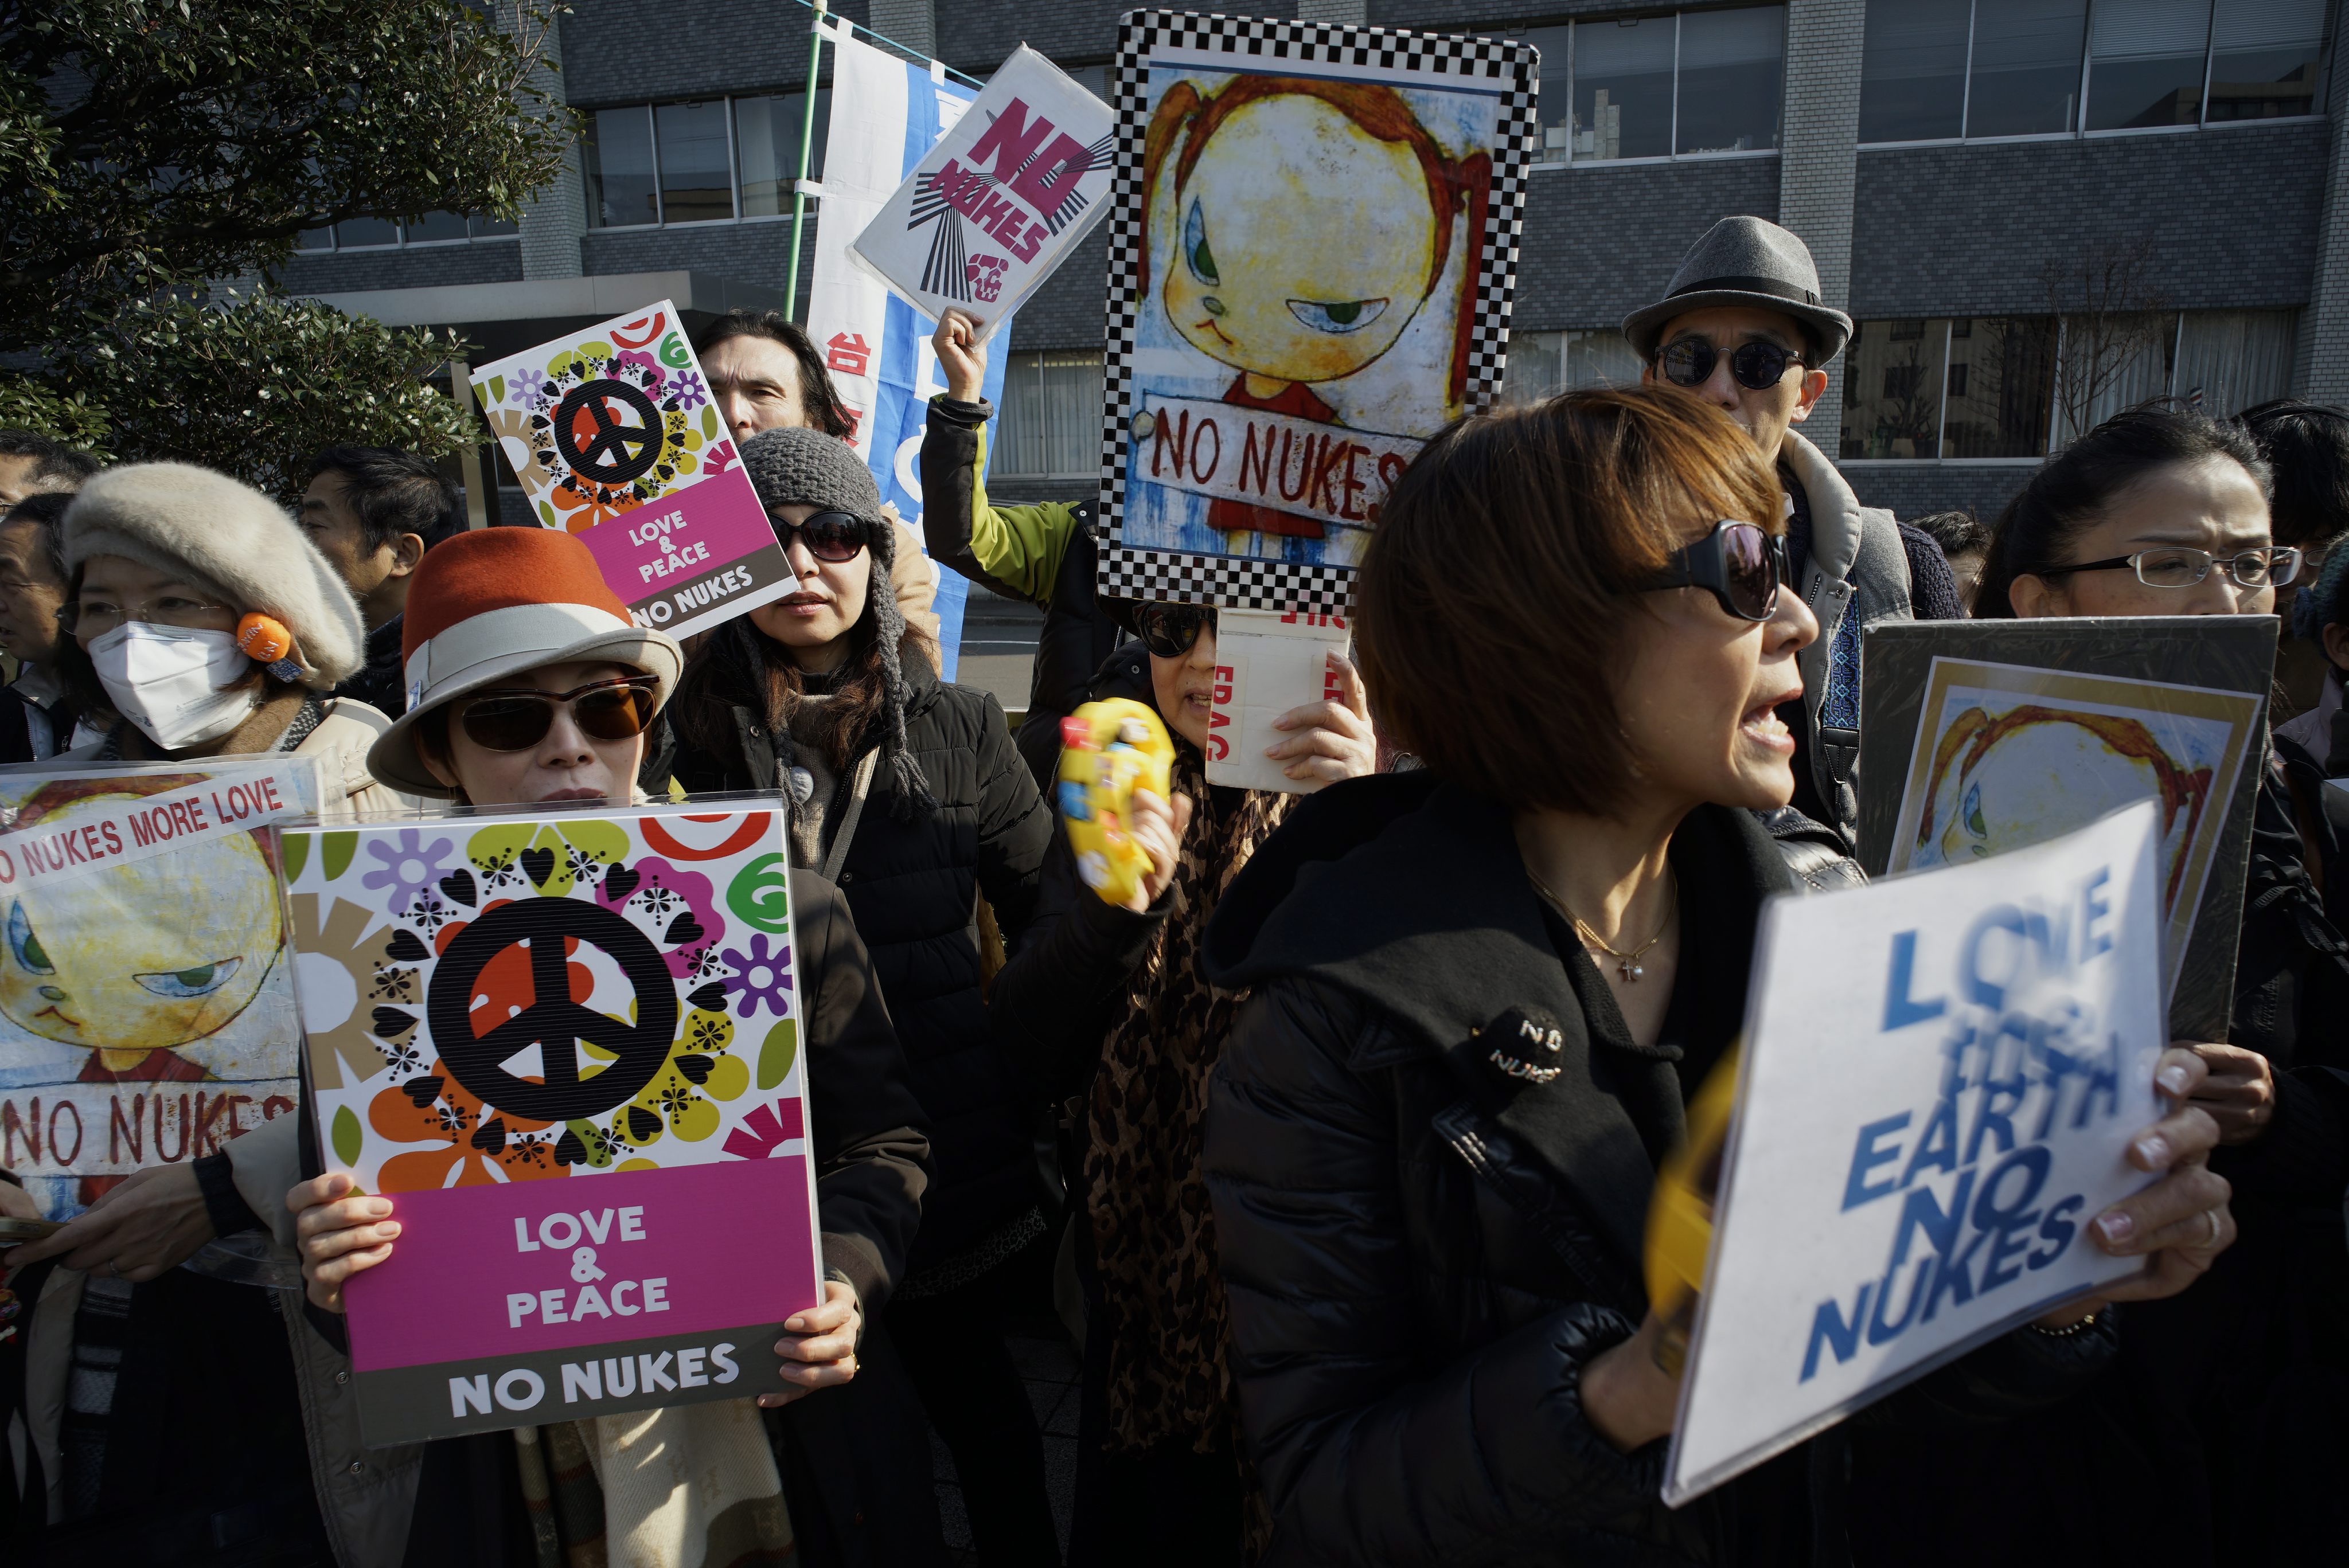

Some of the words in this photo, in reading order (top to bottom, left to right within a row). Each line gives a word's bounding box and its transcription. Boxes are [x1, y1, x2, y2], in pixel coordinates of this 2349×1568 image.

[967, 97, 1095, 219] NO
[928, 158, 1050, 264] NUKES
[1151, 406, 1220, 484] NO
[629, 510, 687, 547] LOVE
[638, 541, 711, 584] PEACE
[659, 535, 677, 554] &
[631, 602, 673, 629] NO
[673, 565, 753, 613] NUKES
[19, 820, 123, 877] NUKES
[128, 796, 209, 848] MORE
[210, 776, 283, 824] LOVE
[3, 1096, 82, 1169] NO
[514, 1206, 646, 1253] LOVE
[1893, 1144, 2051, 1268] NO
[570, 1246, 607, 1283] &
[1798, 1192, 2085, 1385] NUKES
[506, 1277, 670, 1328] PEACE
[448, 1368, 545, 1418] NO
[561, 1343, 740, 1405] NUKES
